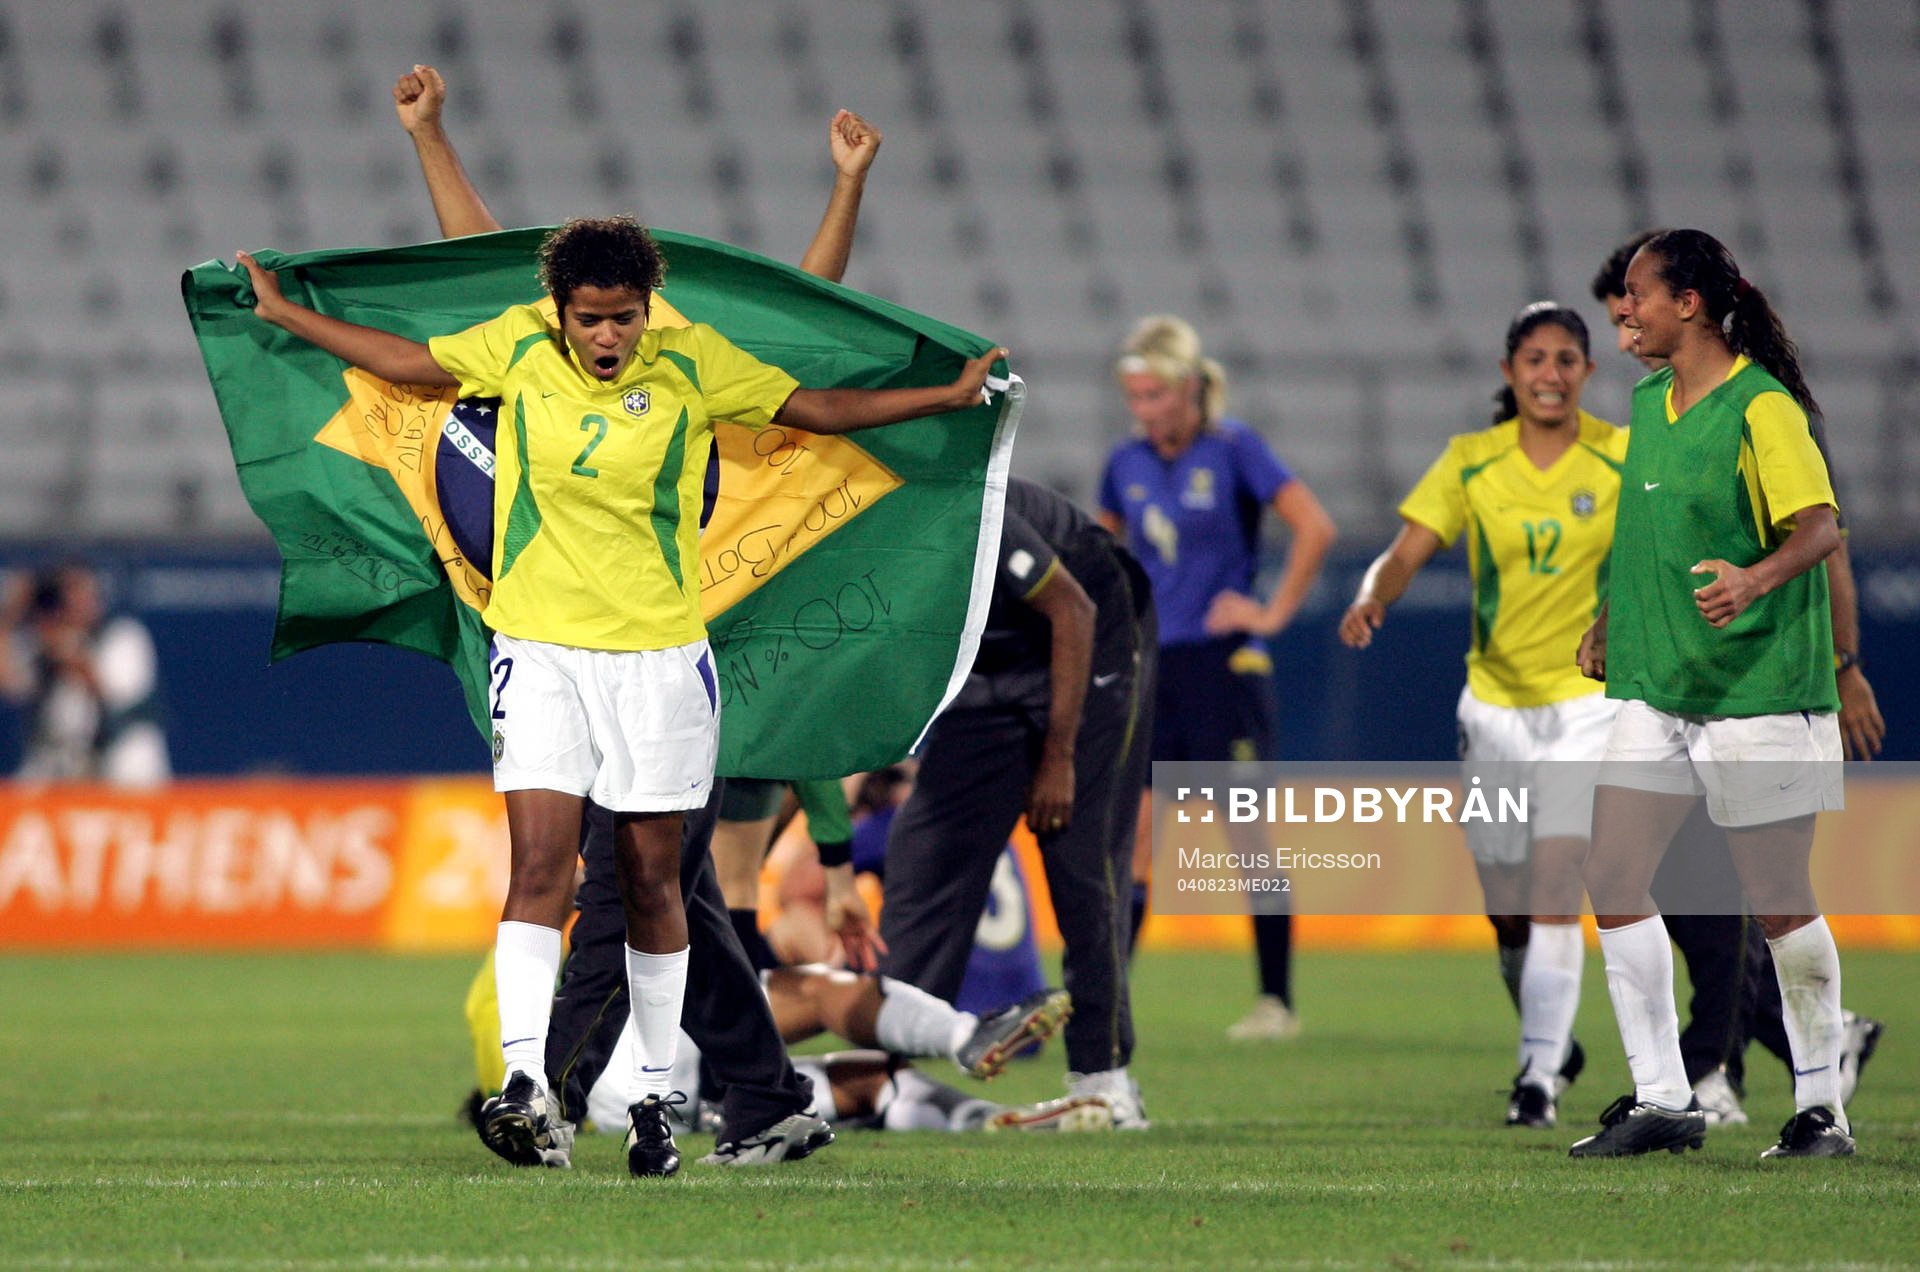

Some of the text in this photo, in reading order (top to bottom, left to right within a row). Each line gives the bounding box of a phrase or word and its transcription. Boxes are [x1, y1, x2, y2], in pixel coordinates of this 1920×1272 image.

[571, 413, 608, 478] 2
[1522, 518, 1563, 575] 12
[492, 657, 513, 719] 2
[0, 808, 394, 912] ATHENS
